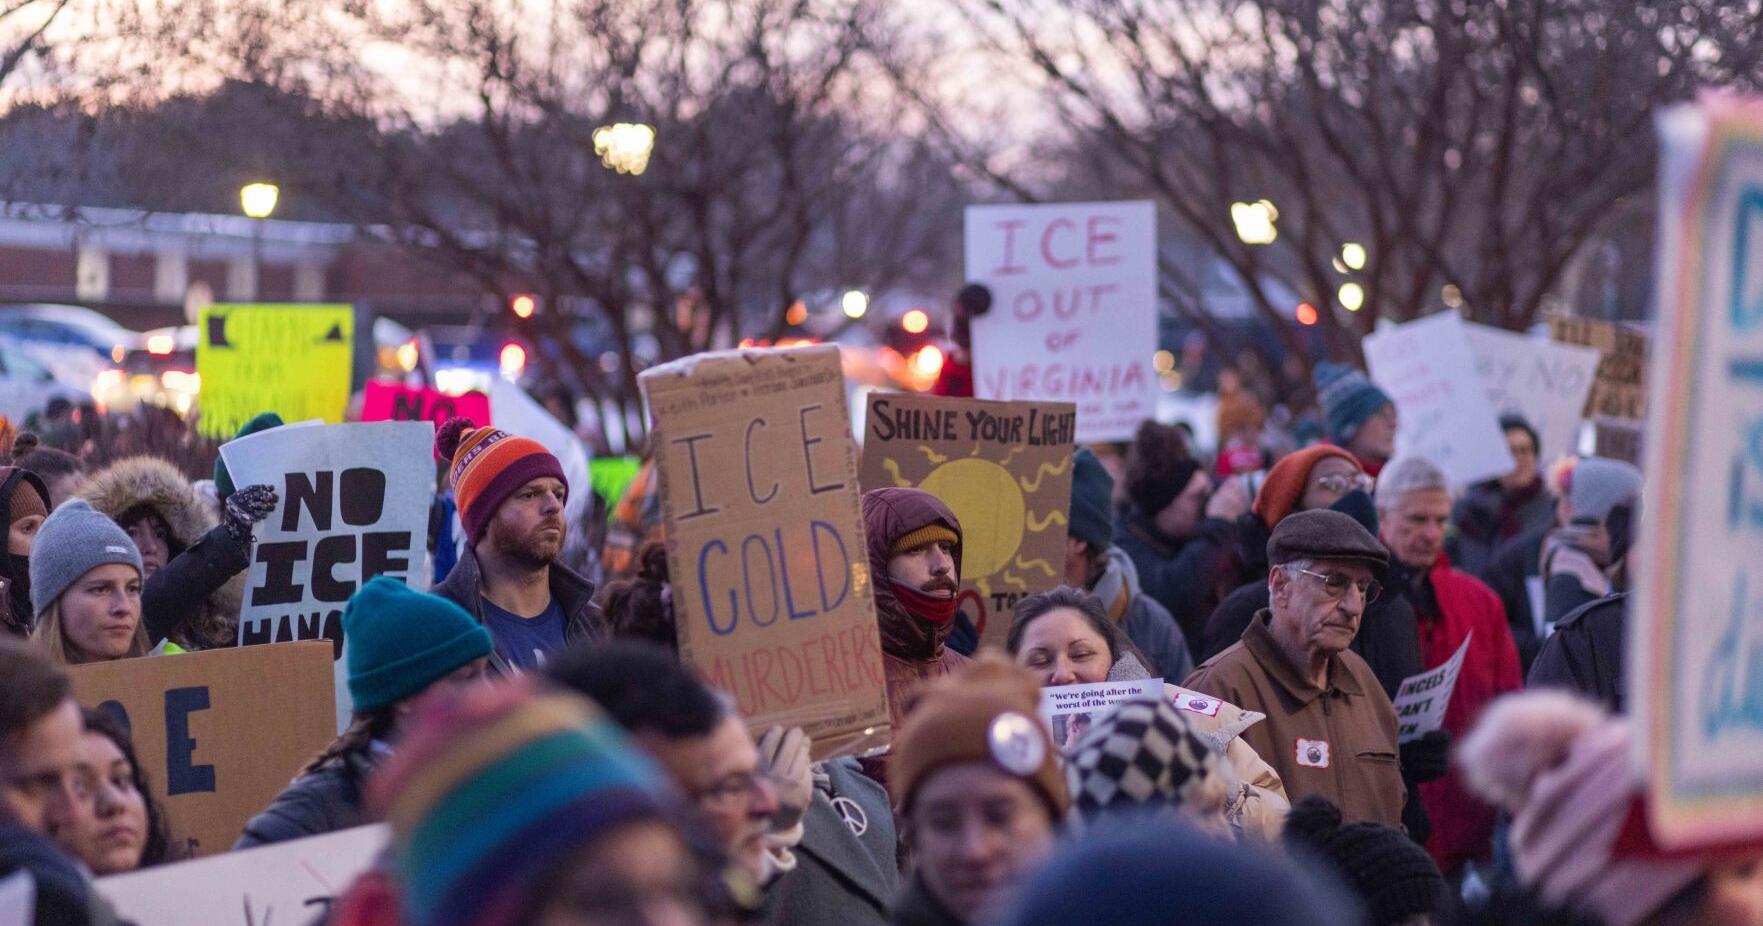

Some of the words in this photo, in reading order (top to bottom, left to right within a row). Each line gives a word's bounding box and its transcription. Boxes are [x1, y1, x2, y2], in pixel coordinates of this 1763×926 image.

[991, 215, 1124, 276] ICE
[1011, 284, 1120, 322] OUT
[1045, 329, 1081, 352] OF
[982, 360, 1148, 400] VIRGINIA
[872, 400, 958, 441] SHINE
[965, 409, 1024, 444] YOUR
[1029, 408, 1076, 446] LIGHT
[671, 405, 845, 521] ICE
[281, 467, 386, 532] NO
[251, 531, 411, 607] ICE
[697, 520, 850, 636] COLD
[1056, 701, 1080, 709] worst
[1082, 699, 1091, 707] of
[1081, 689, 1104, 699] going
[1106, 688, 1126, 696] after
[1128, 687, 1142, 695] the
[1401, 669, 1446, 697] INCELS
